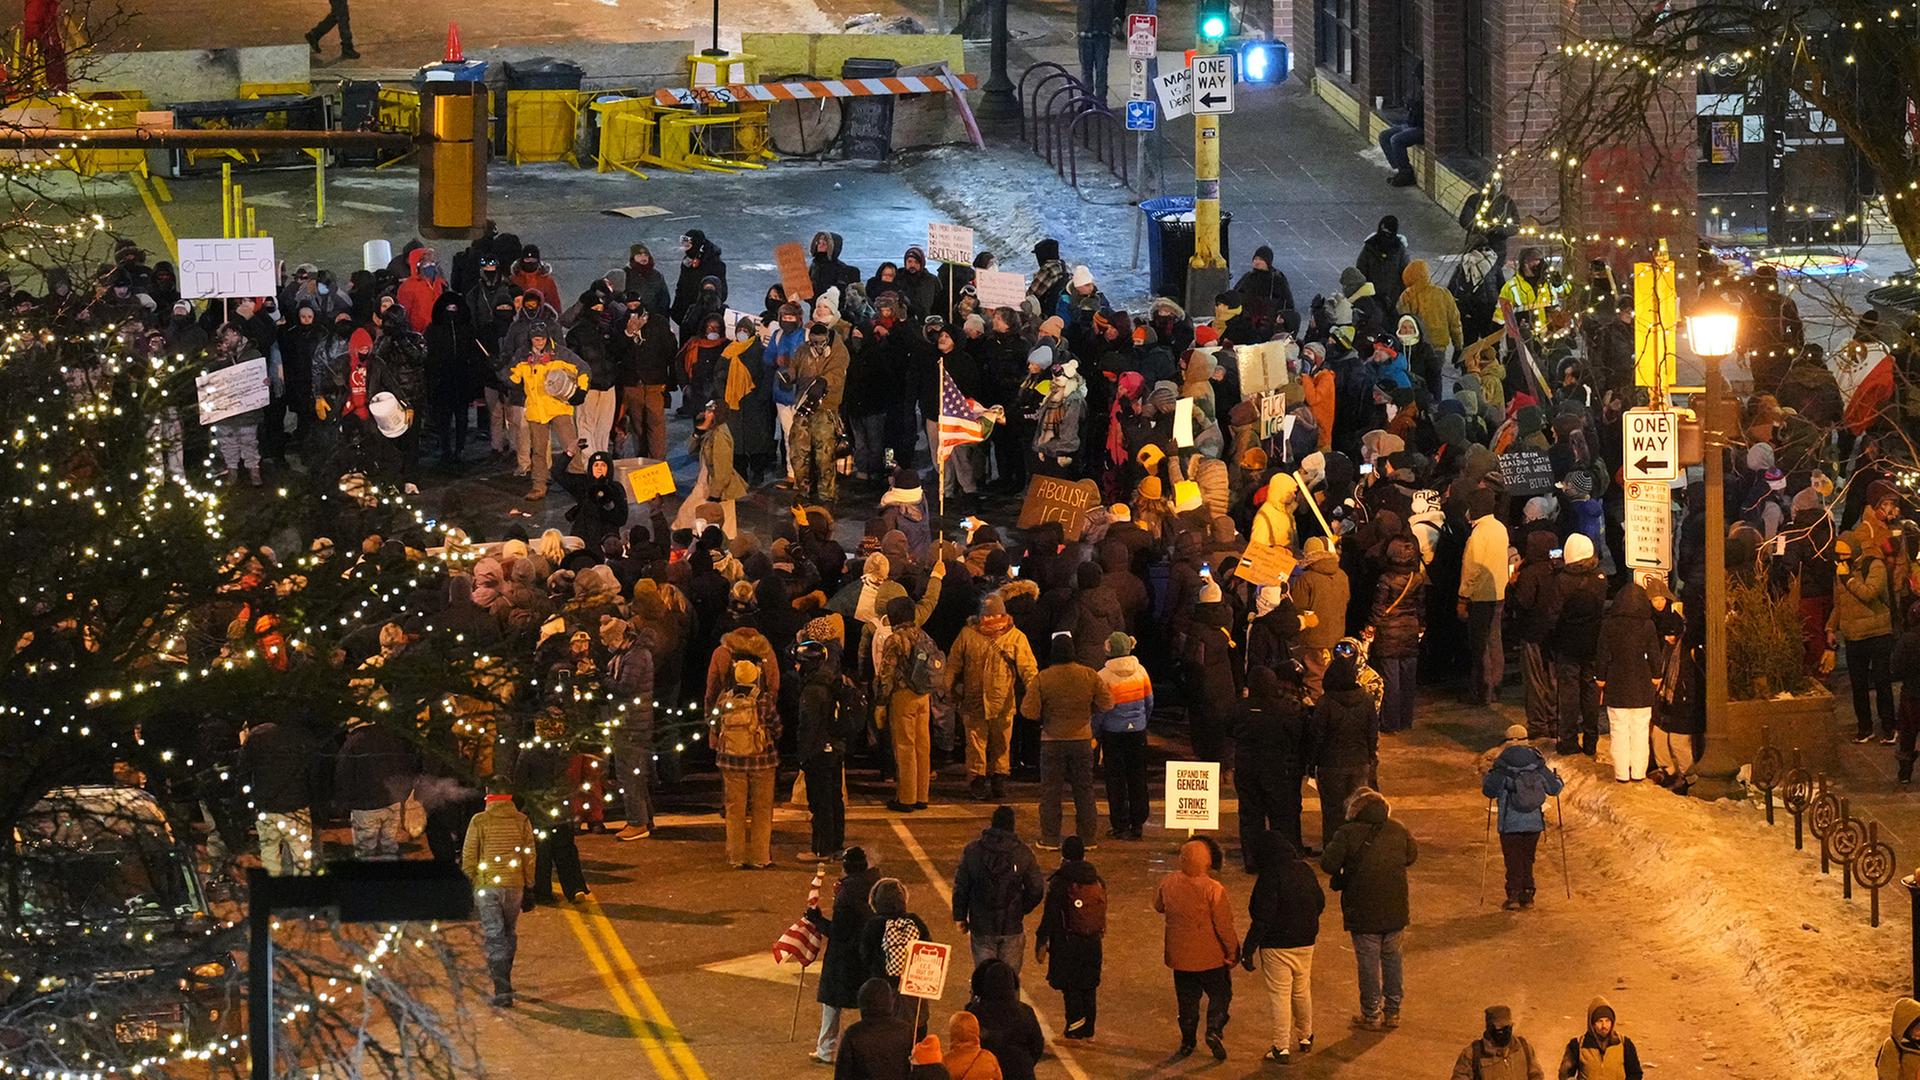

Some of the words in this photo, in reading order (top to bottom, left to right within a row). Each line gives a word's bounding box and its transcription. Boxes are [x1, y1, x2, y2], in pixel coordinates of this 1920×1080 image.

[1198, 60, 1226, 74] ONE
[1163, 69, 1192, 88] MAG
[1197, 76, 1226, 89] WAY
[1170, 88, 1182, 97] IS
[1169, 94, 1192, 109] DEAT
[194, 243, 256, 262] ICE
[928, 246, 958, 262] ABOLISH
[196, 271, 258, 293] OUT
[1634, 418, 1667, 433] ONE
[1632, 436, 1668, 451] WAY
[1500, 459, 1529, 468] DEALING
[1532, 456, 1550, 464] WITH
[1516, 466, 1531, 474] OUR
[1533, 464, 1552, 472] WHOLE
[1529, 477, 1551, 488] BITCH
[1037, 480, 1089, 508] ABOLISH
[1040, 505, 1077, 532] ICE!
[1177, 770, 1198, 778] EXPAND
[1200, 770, 1209, 779] THE
[1177, 779, 1208, 791] GENERAL
[1179, 797, 1207, 809] STRIKE!
